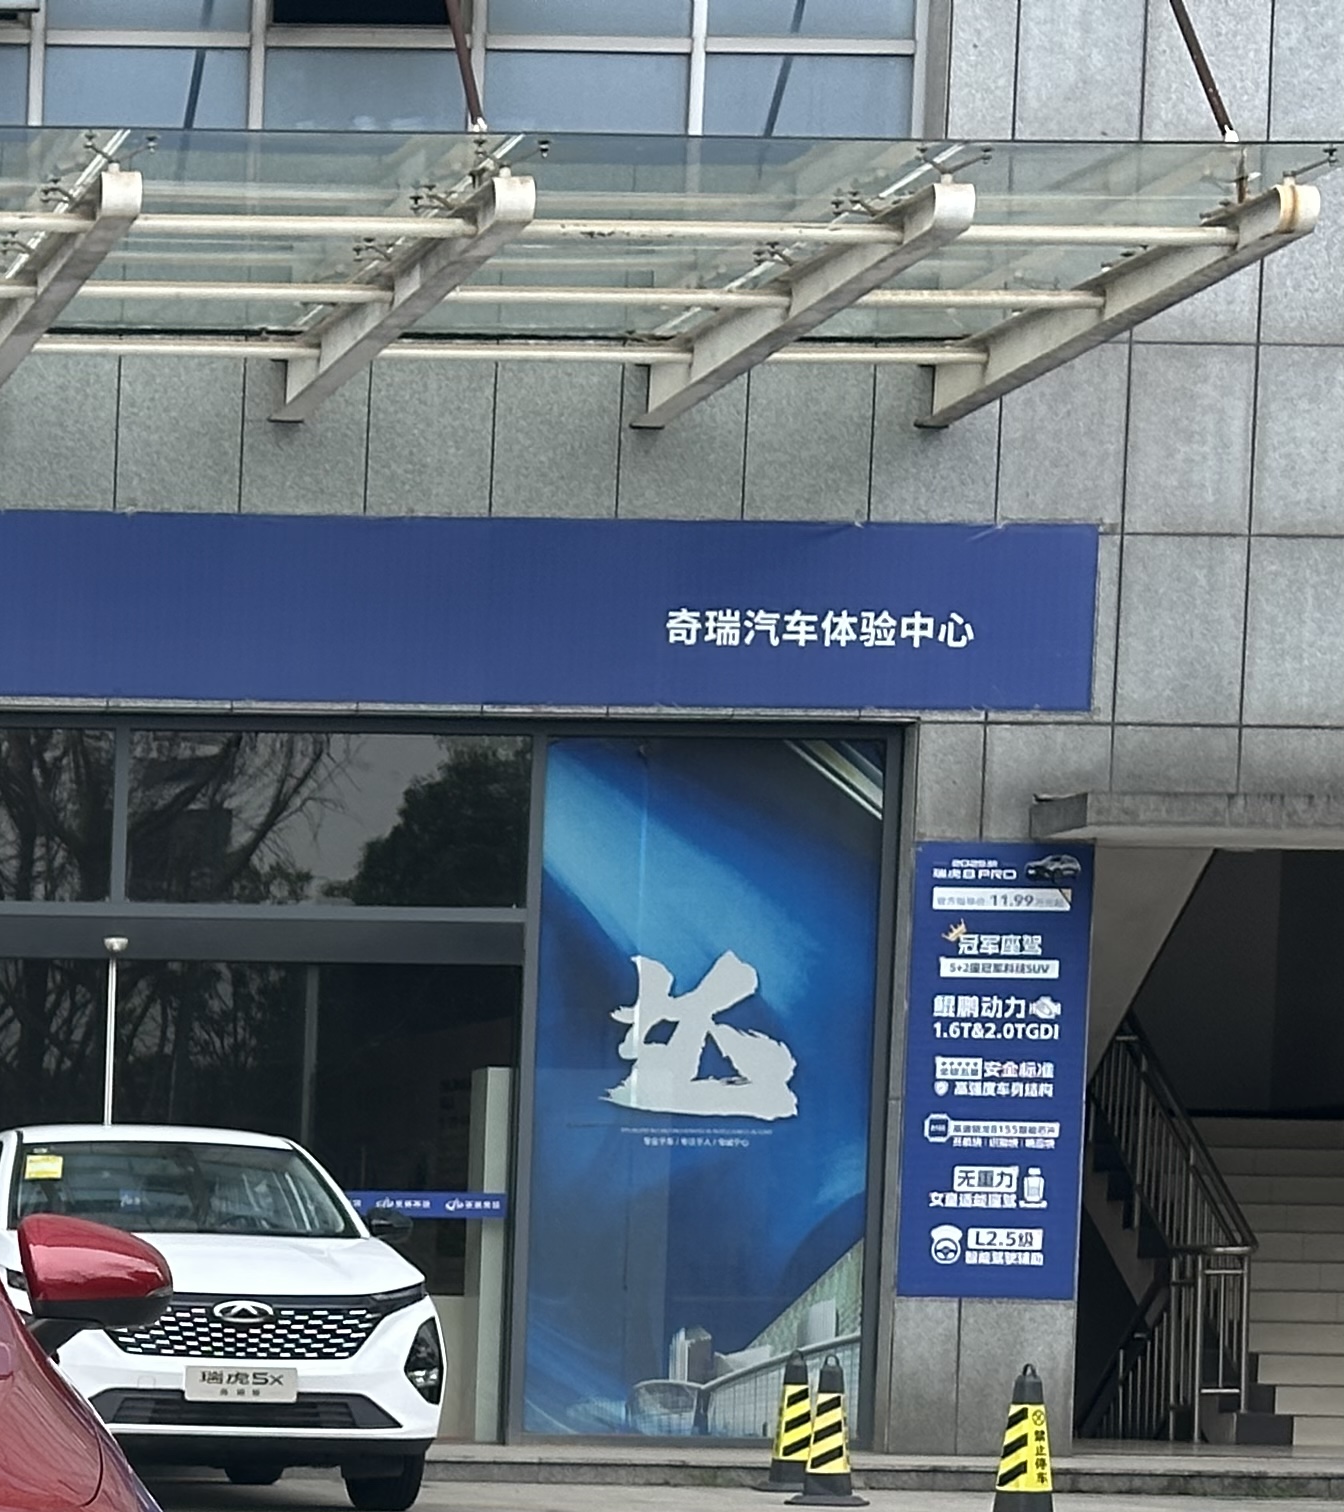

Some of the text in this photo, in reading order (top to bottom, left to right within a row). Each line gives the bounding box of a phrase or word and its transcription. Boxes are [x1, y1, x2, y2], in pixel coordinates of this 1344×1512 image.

[665, 607, 975, 649] 奇瑞汽车体验中心
[977, 868, 1017, 880] PRO
[989, 893, 1034, 907] 11.99
[958, 933, 1043, 956] 冠军座驾
[933, 994, 1026, 1019] 鲲鹏动力
[933, 1021, 1060, 1040] 1.6T&2.0TGDI
[983, 1060, 1055, 1079] 安全标准
[957, 1169, 1013, 1188] 无重力
[975, 1230, 1034, 1248] L2.5级
